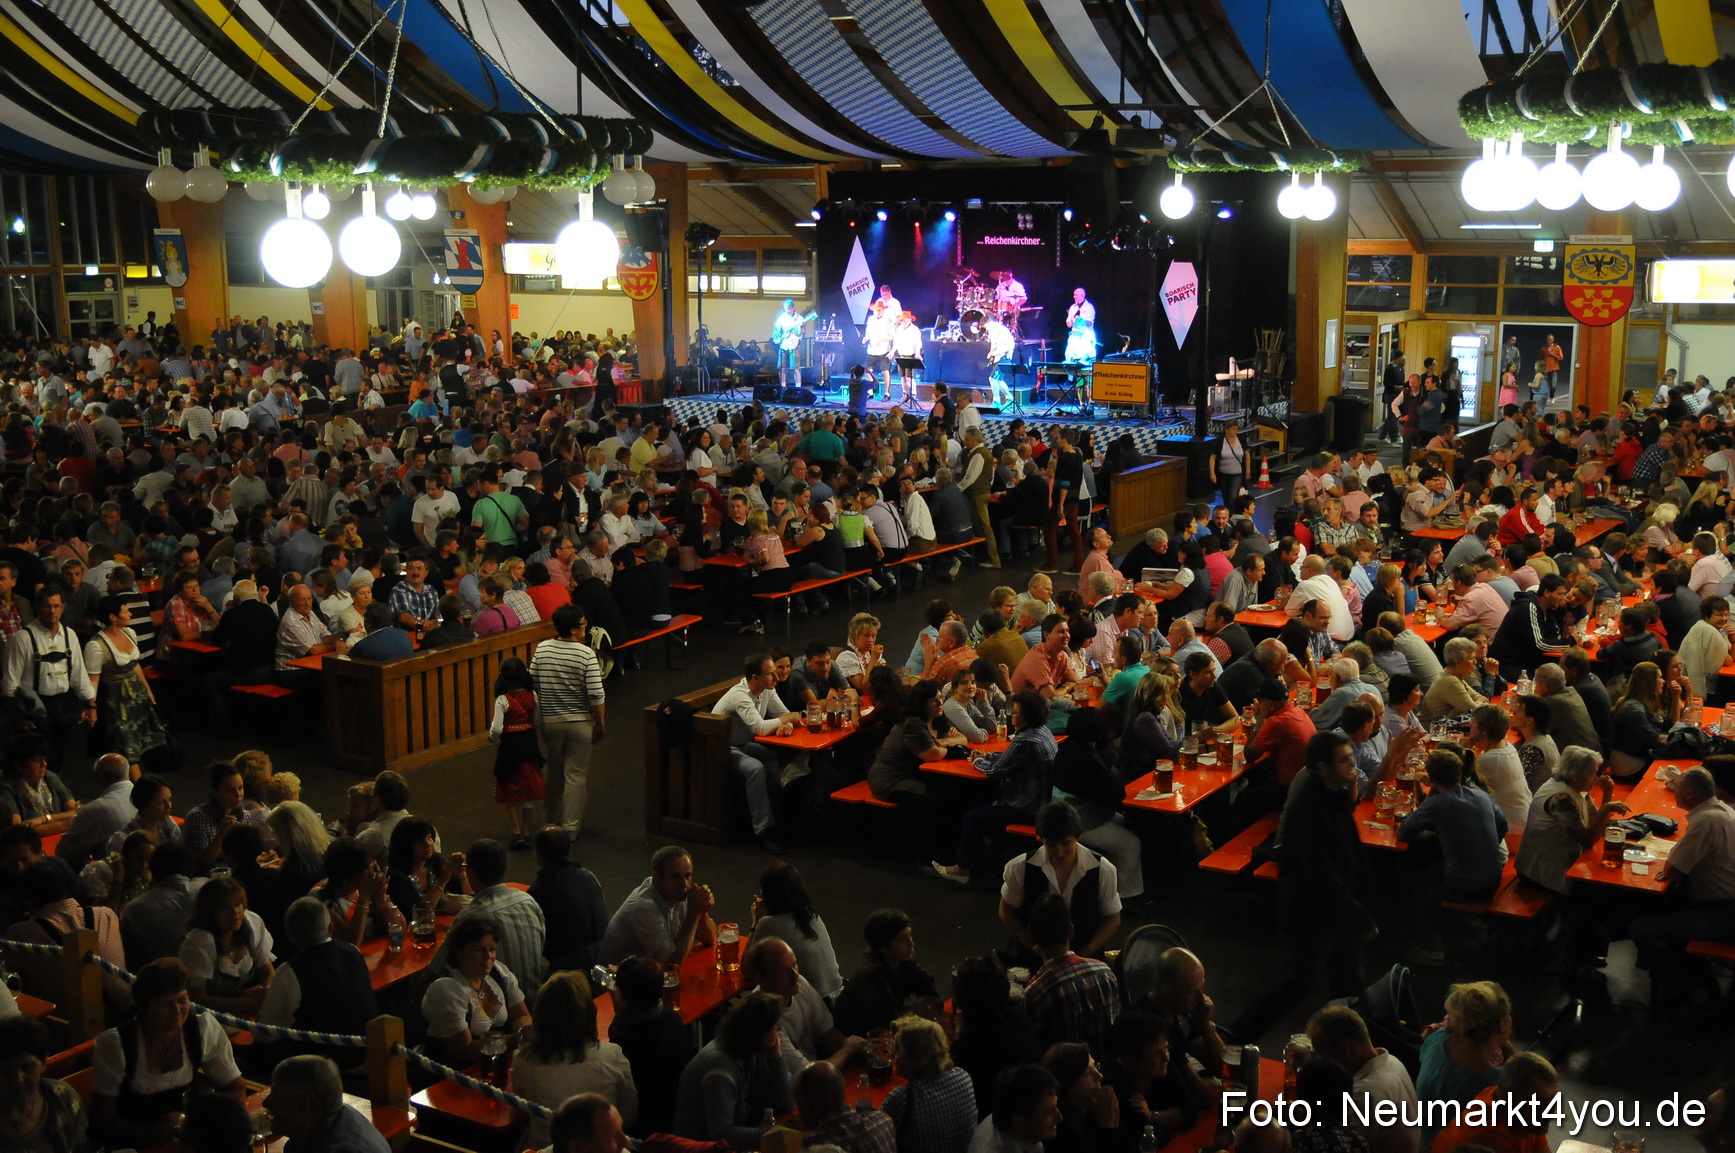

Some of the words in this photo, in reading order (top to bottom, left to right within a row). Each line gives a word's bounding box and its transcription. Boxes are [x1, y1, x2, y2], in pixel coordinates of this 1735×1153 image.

[848, 281, 869, 298] PARTY
[1165, 282, 1194, 298] BOARISCH
[1167, 288, 1196, 306] PARTY
